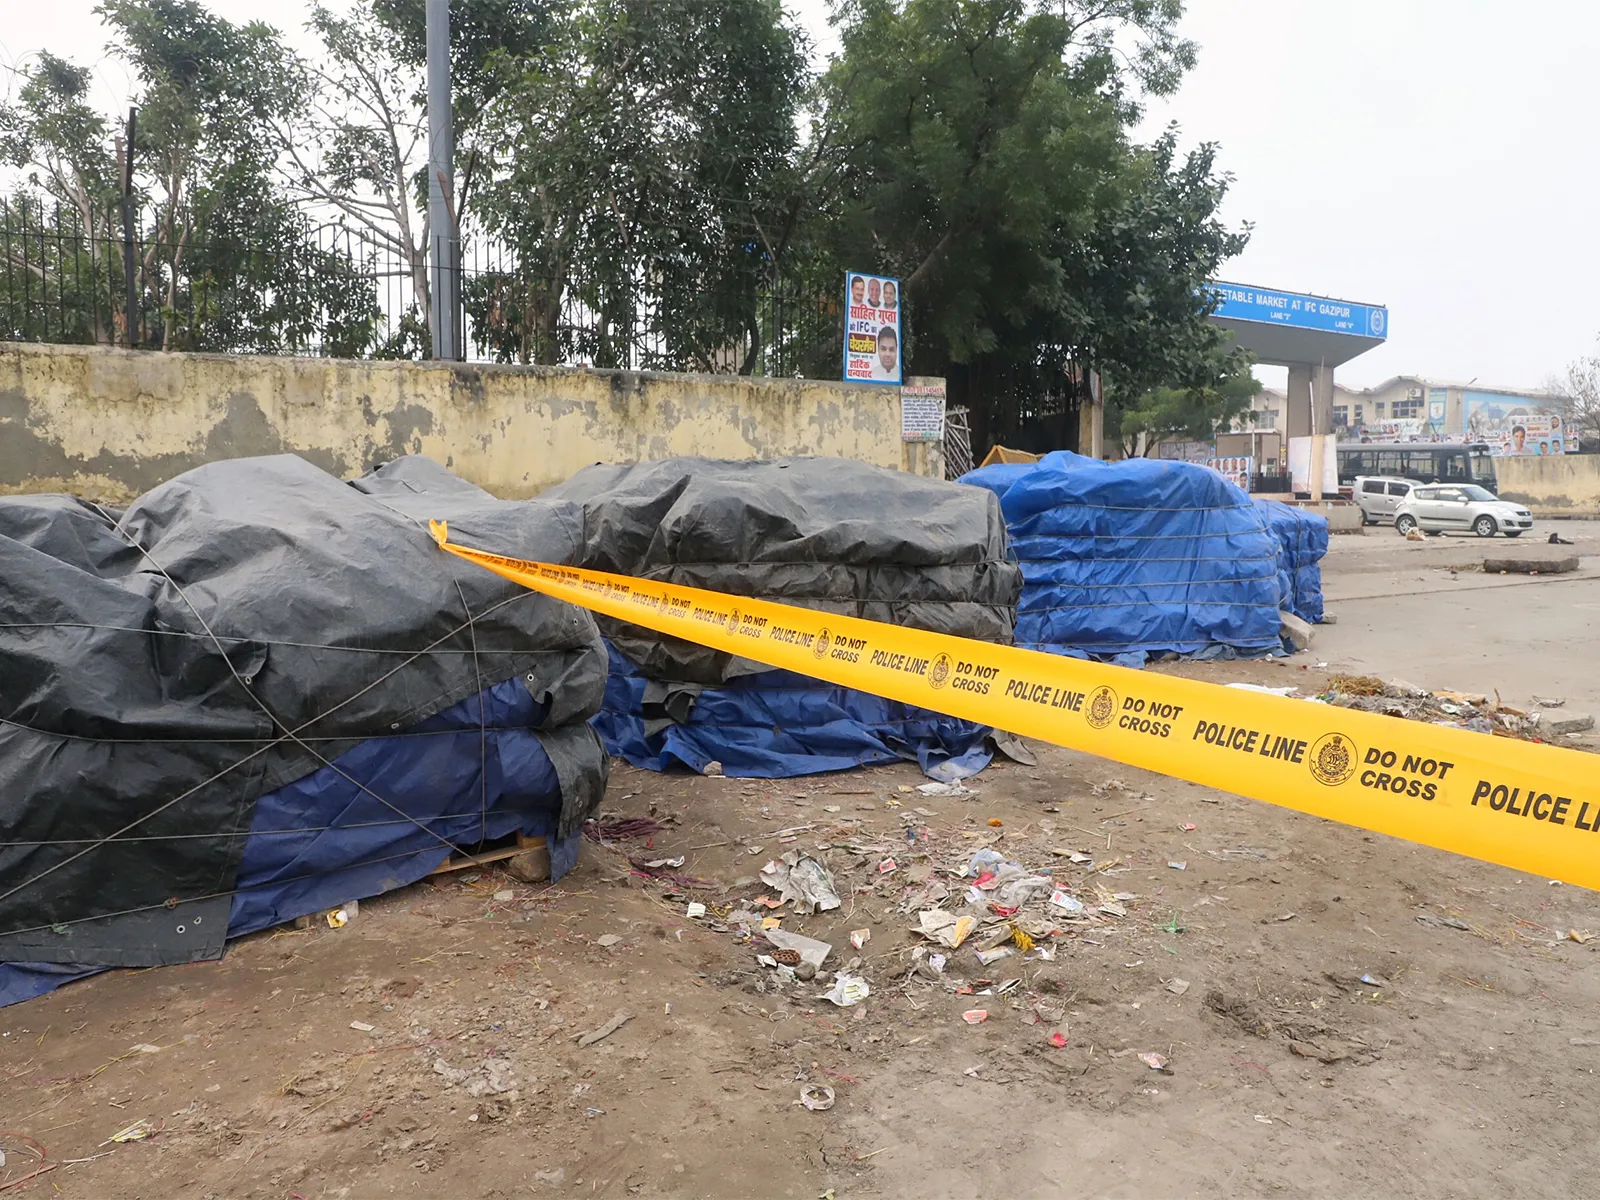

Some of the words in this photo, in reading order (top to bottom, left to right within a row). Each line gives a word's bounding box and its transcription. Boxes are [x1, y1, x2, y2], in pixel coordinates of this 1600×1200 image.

[850, 304, 876, 320] साहिल
[878, 309, 897, 324] गुप्ता
[1256, 294, 1288, 309] MARKET
[1291, 300, 1302, 311] AT
[1305, 302, 1316, 312] IFC
[1319, 304, 1350, 317] GAZIPUR
[856, 321, 870, 332] IFC
[668, 607, 686, 618] CROSS
[671, 597, 679, 606] DO
[679, 599, 691, 608] NOT
[692, 607, 714, 622] POLICE
[712, 612, 727, 626] LINE
[743, 615, 753, 624] DO
[753, 616, 768, 627] NOT
[739, 625, 762, 638] CROSS
[769, 626, 796, 644] POLICE
[794, 631, 815, 648] LINE
[834, 635, 847, 646] DO
[848, 638, 867, 651] NOT
[830, 648, 860, 663] CROSS
[870, 649, 905, 670] POLICE
[904, 656, 929, 676] LINE
[956, 661, 973, 675] DO
[974, 665, 1000, 680] NOT
[952, 677, 990, 695] CROSS
[1005, 679, 1052, 705] POLICE
[1051, 688, 1085, 713] LINE
[1122, 696, 1144, 713] DO
[1149, 701, 1183, 721] NOT
[1119, 715, 1171, 738] CROSS
[1193, 720, 1259, 752] POLICE
[1260, 734, 1307, 764] LINE
[1364, 747, 1397, 768] DO
[1402, 755, 1454, 780] NOT
[1360, 770, 1438, 801] CROSS
[1471, 780, 1572, 825] POLICE
